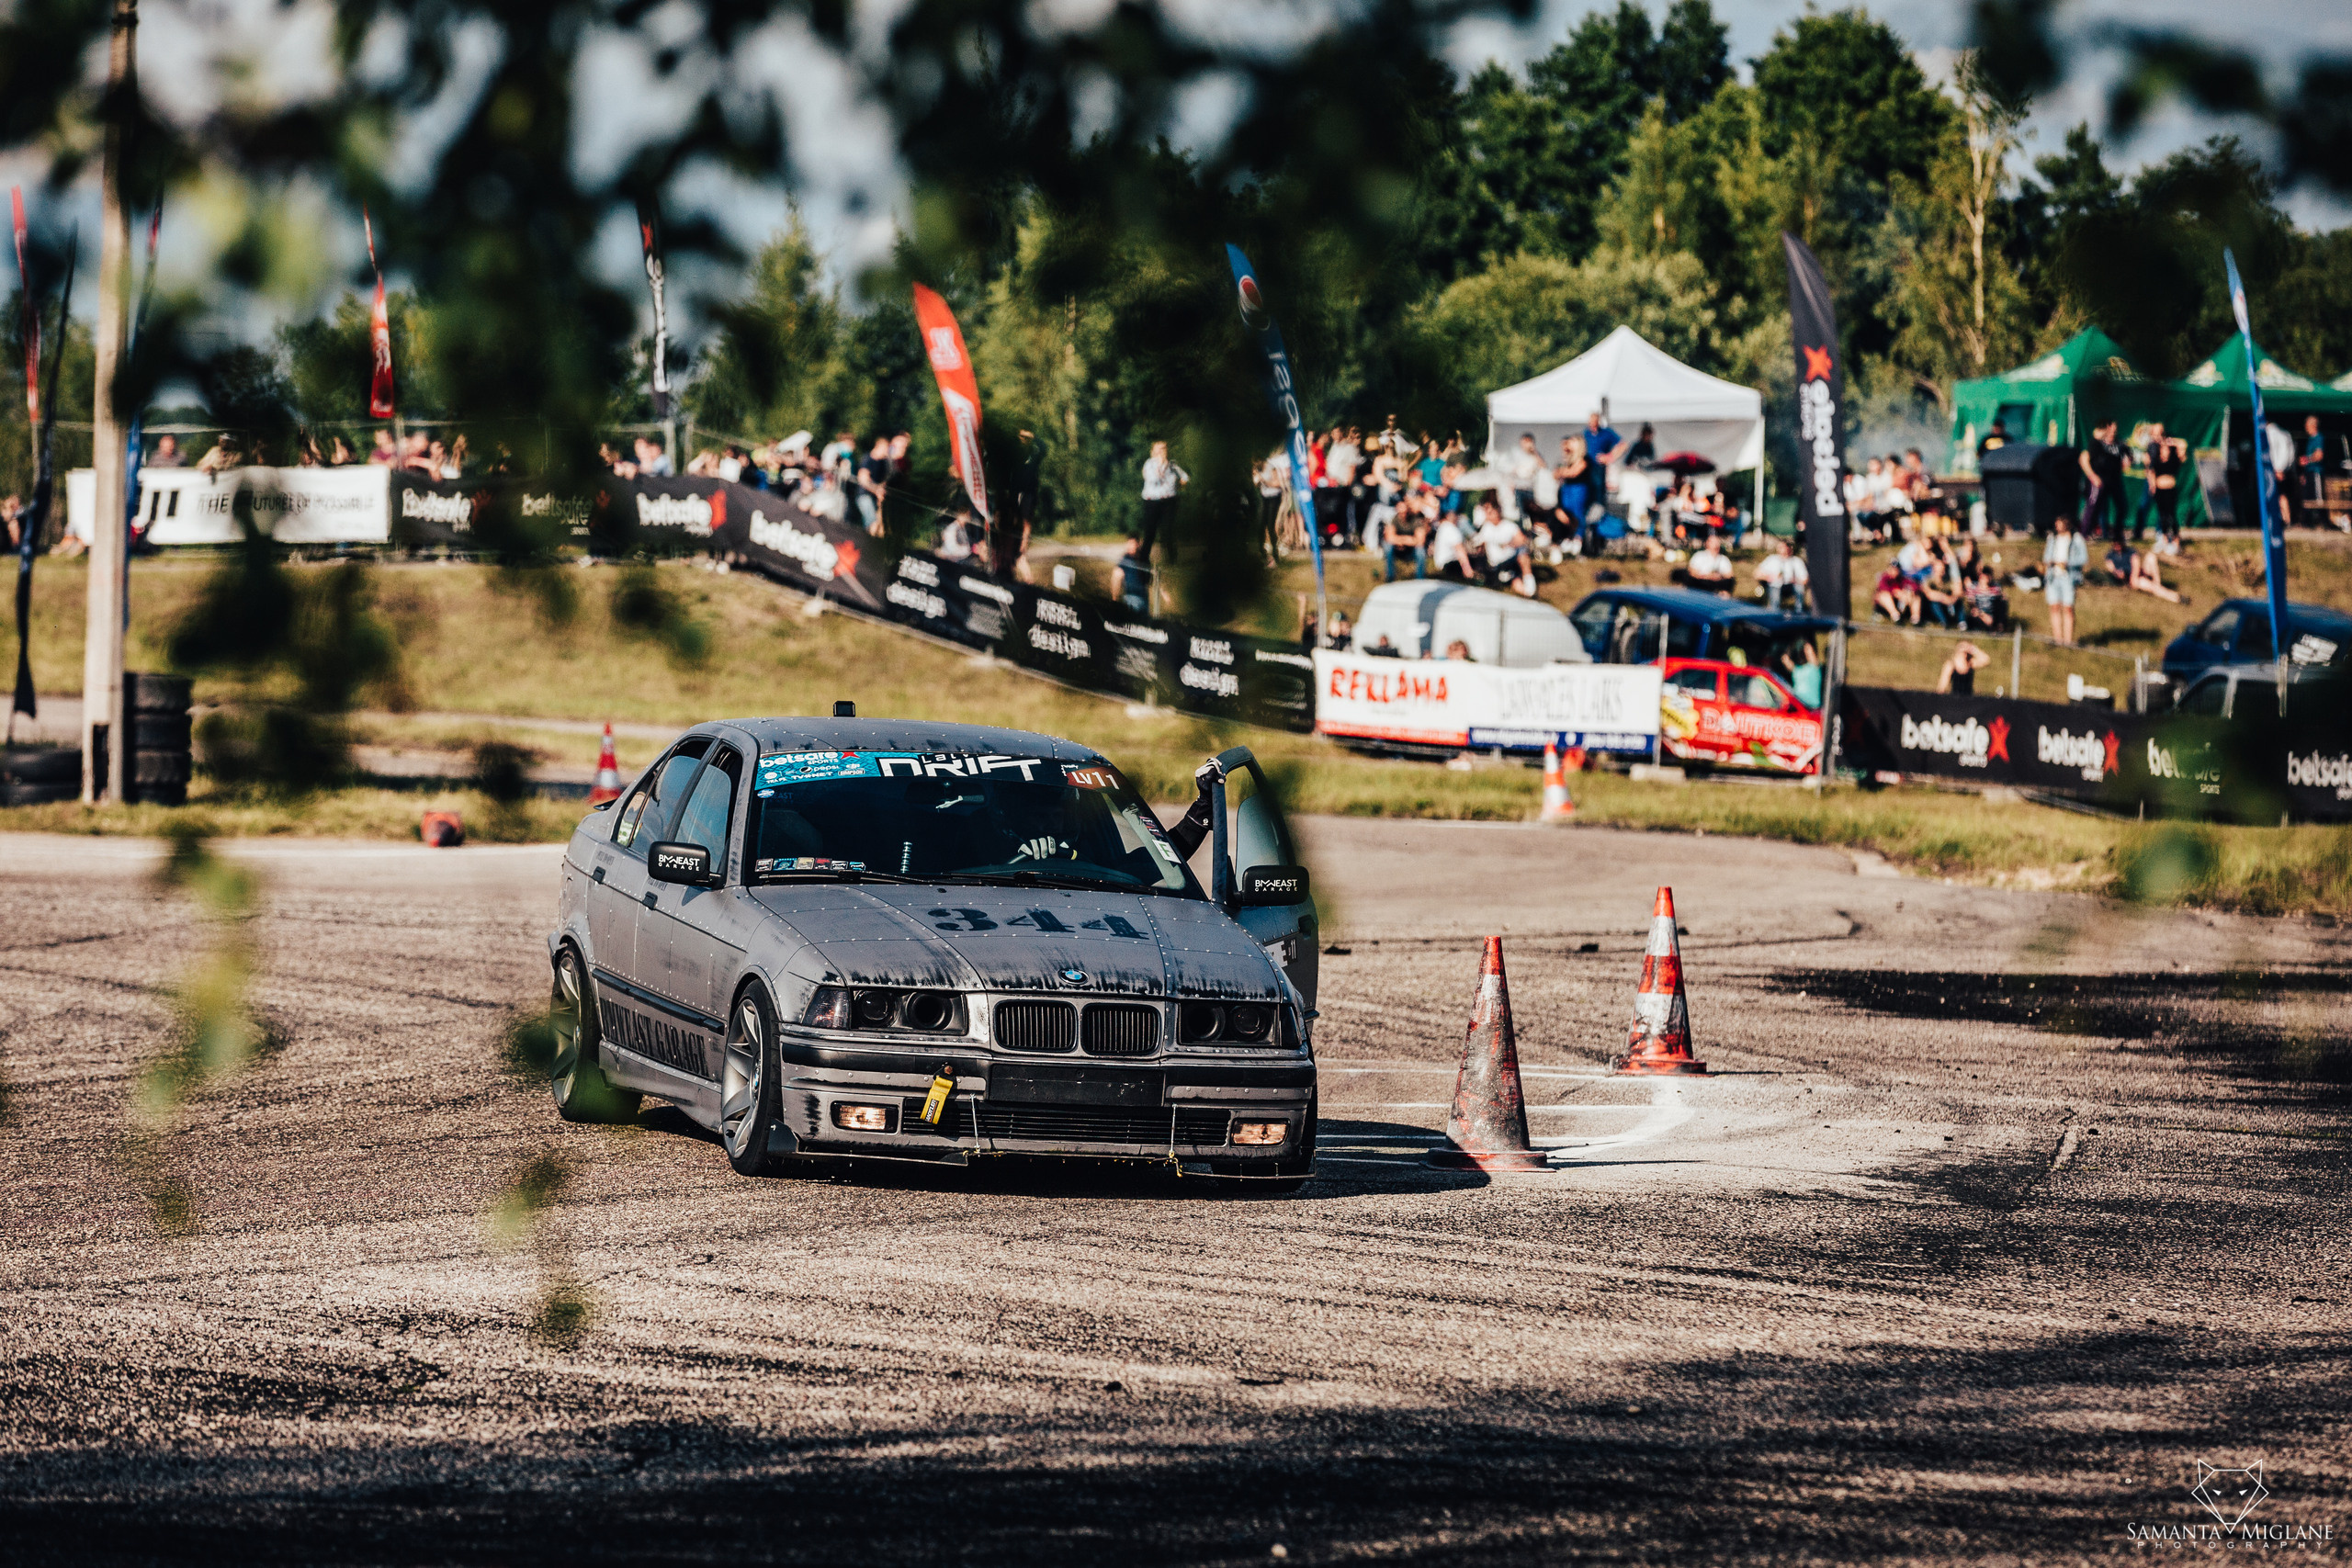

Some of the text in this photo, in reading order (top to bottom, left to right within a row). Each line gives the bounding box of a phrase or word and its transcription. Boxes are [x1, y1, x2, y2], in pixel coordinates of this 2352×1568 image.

[1901, 713, 1989, 755] betsafe
[2038, 725, 2106, 770] betsafe
[1070, 771, 1120, 790] LV11
[658, 863, 700, 872] GARAGE
[927, 908, 1149, 940] 344
